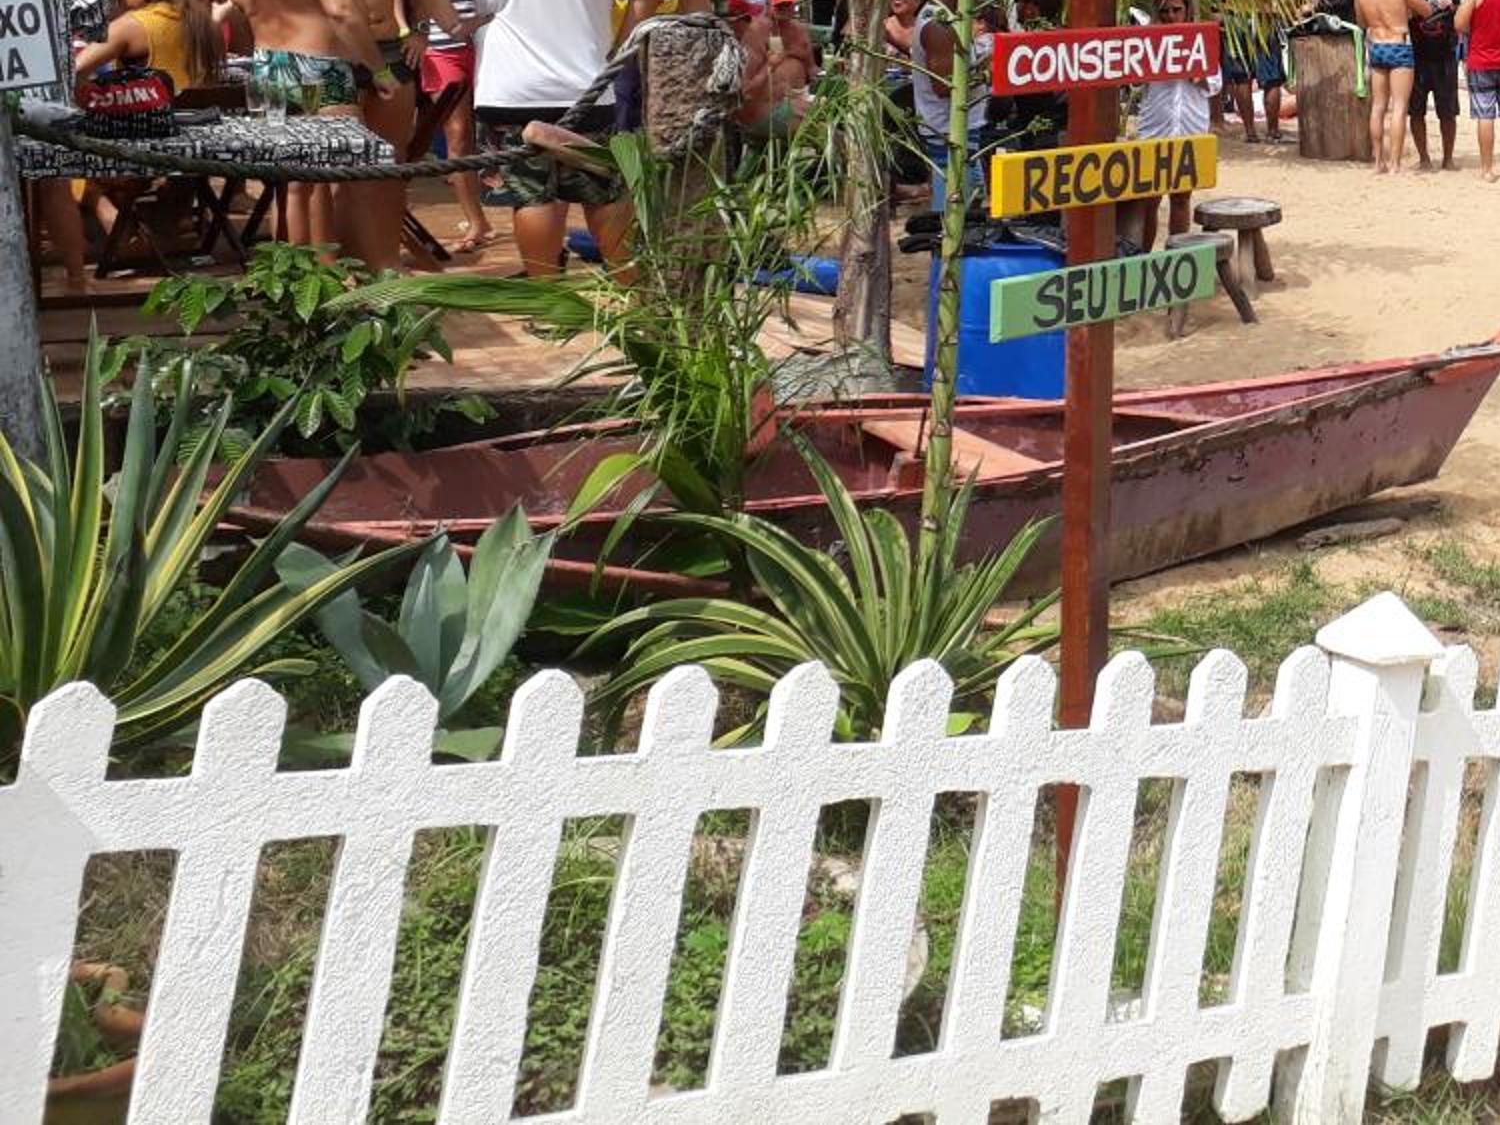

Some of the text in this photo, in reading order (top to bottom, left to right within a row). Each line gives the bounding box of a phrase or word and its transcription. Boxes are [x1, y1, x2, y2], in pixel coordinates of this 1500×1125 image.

[0, 47, 30, 81] A
[1007, 33, 1208, 86] CONSERVE-A
[1023, 139, 1198, 211] RECOLHA
[1033, 252, 1198, 328] SEU LIXO
